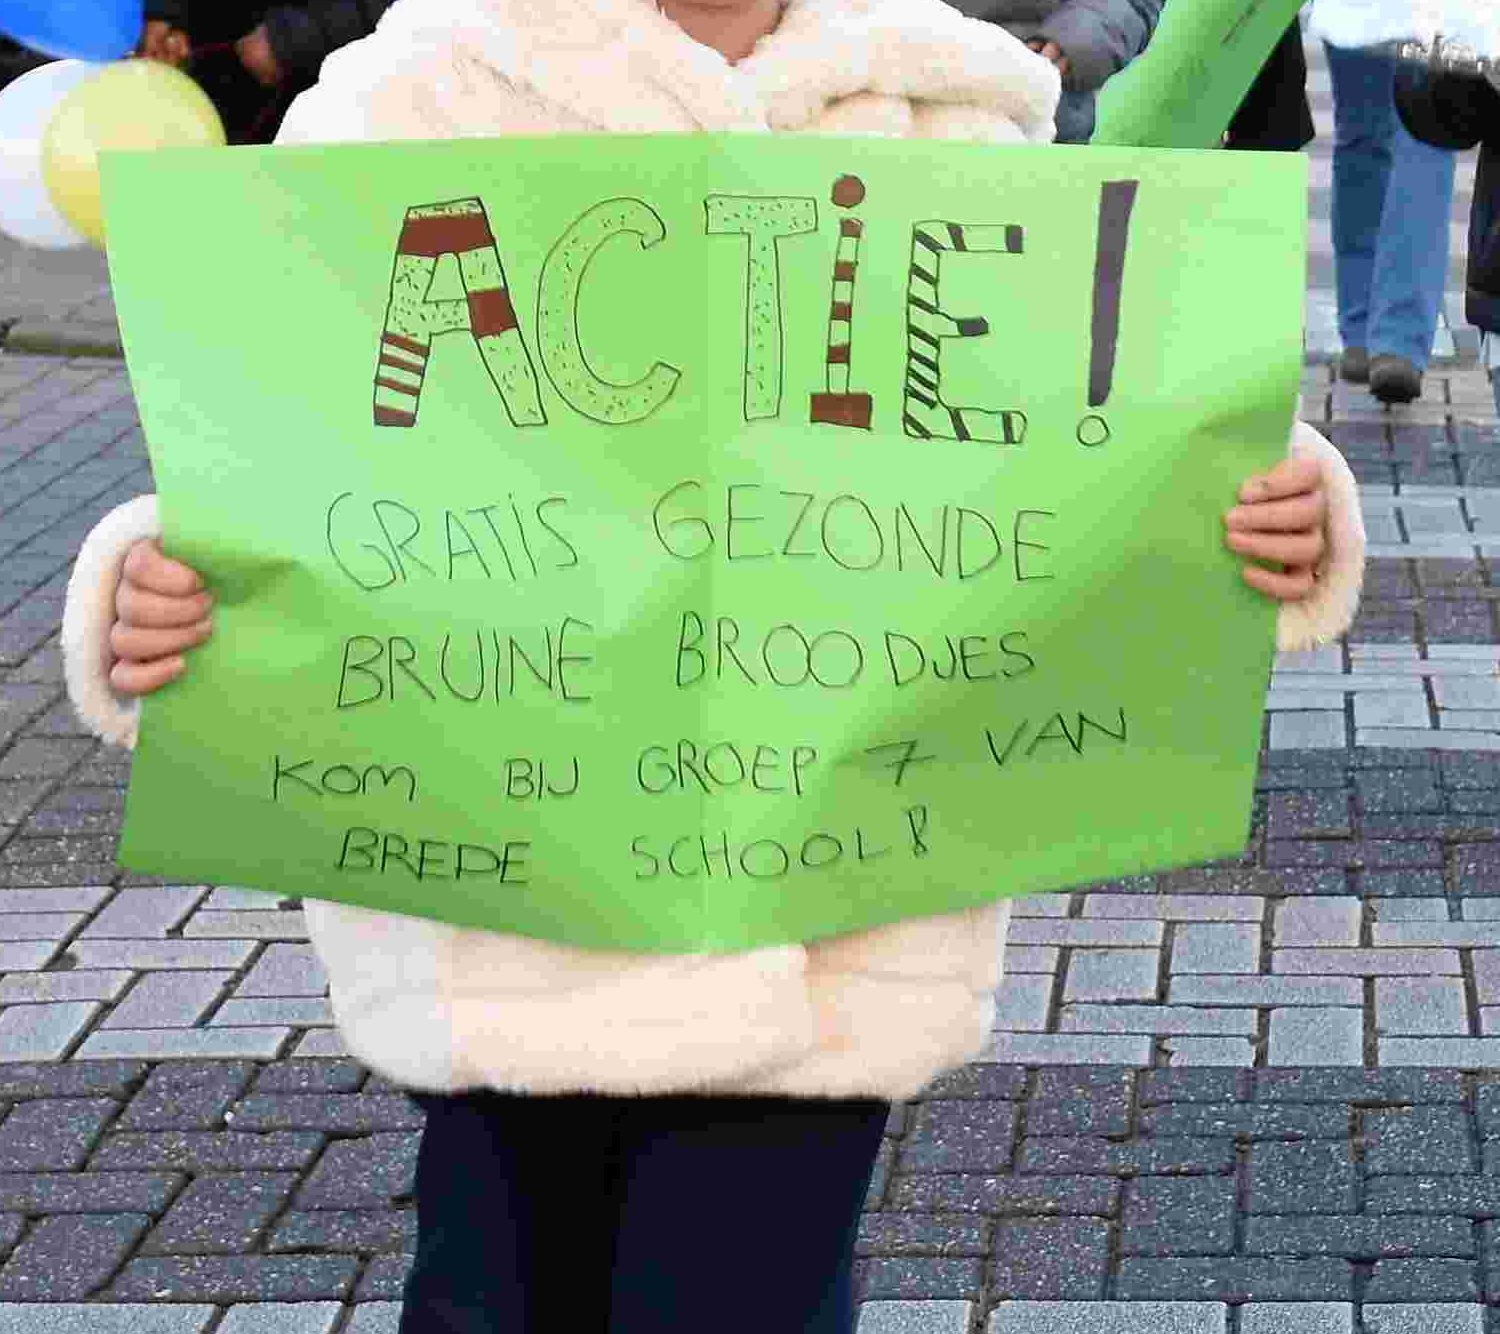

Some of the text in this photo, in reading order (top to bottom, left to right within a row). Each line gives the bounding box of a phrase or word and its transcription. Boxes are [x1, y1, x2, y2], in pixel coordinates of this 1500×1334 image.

[652, 480, 1057, 581] GEZONDE
[336, 610, 1036, 709] BRUINE BROODJES
[637, 738, 818, 796] GROEP
[864, 739, 938, 787] 7
[983, 707, 1129, 767] VAN
[336, 826, 532, 884] BREDE
